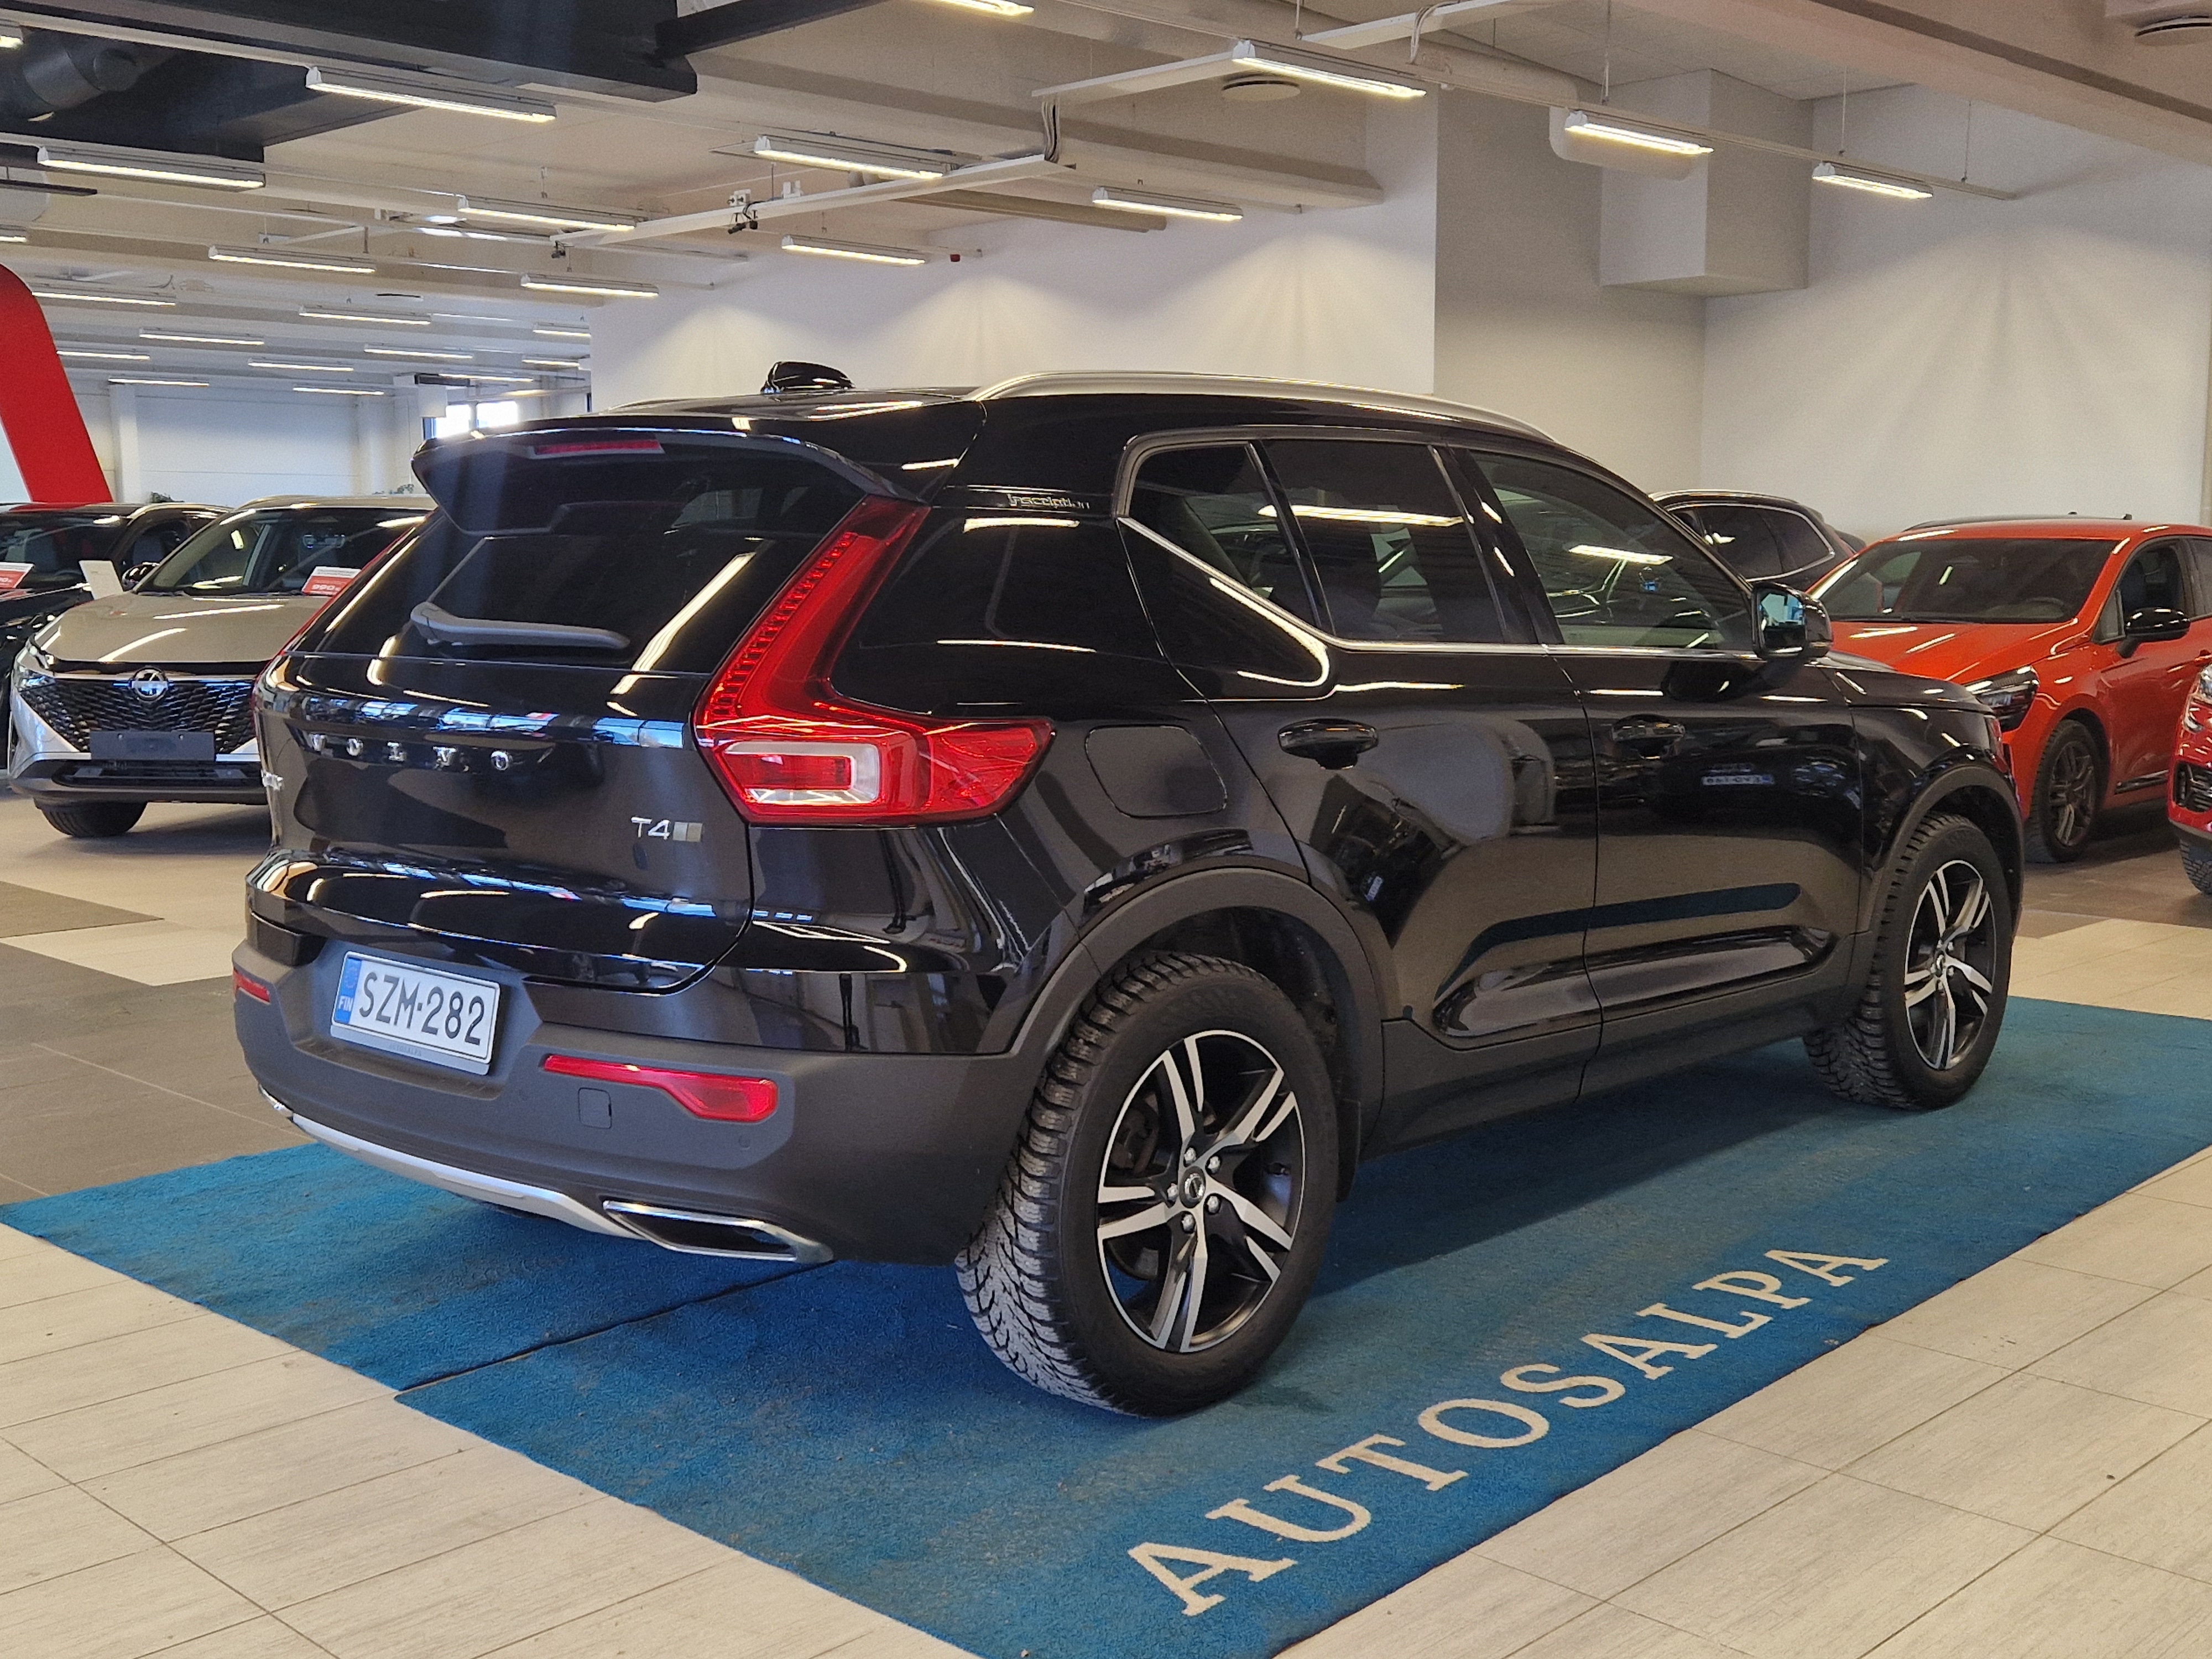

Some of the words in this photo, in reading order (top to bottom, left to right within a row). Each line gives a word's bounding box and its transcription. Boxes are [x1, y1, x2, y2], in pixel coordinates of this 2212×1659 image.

[1006, 493, 1090, 509] Inscription
[307, 733, 511, 771] VOLVO
[631, 817, 671, 840] T4
[338, 995, 354, 1012] FIN
[359, 972, 485, 1046] SZM-282
[1127, 1248, 1889, 1616] AUTOSALPA
